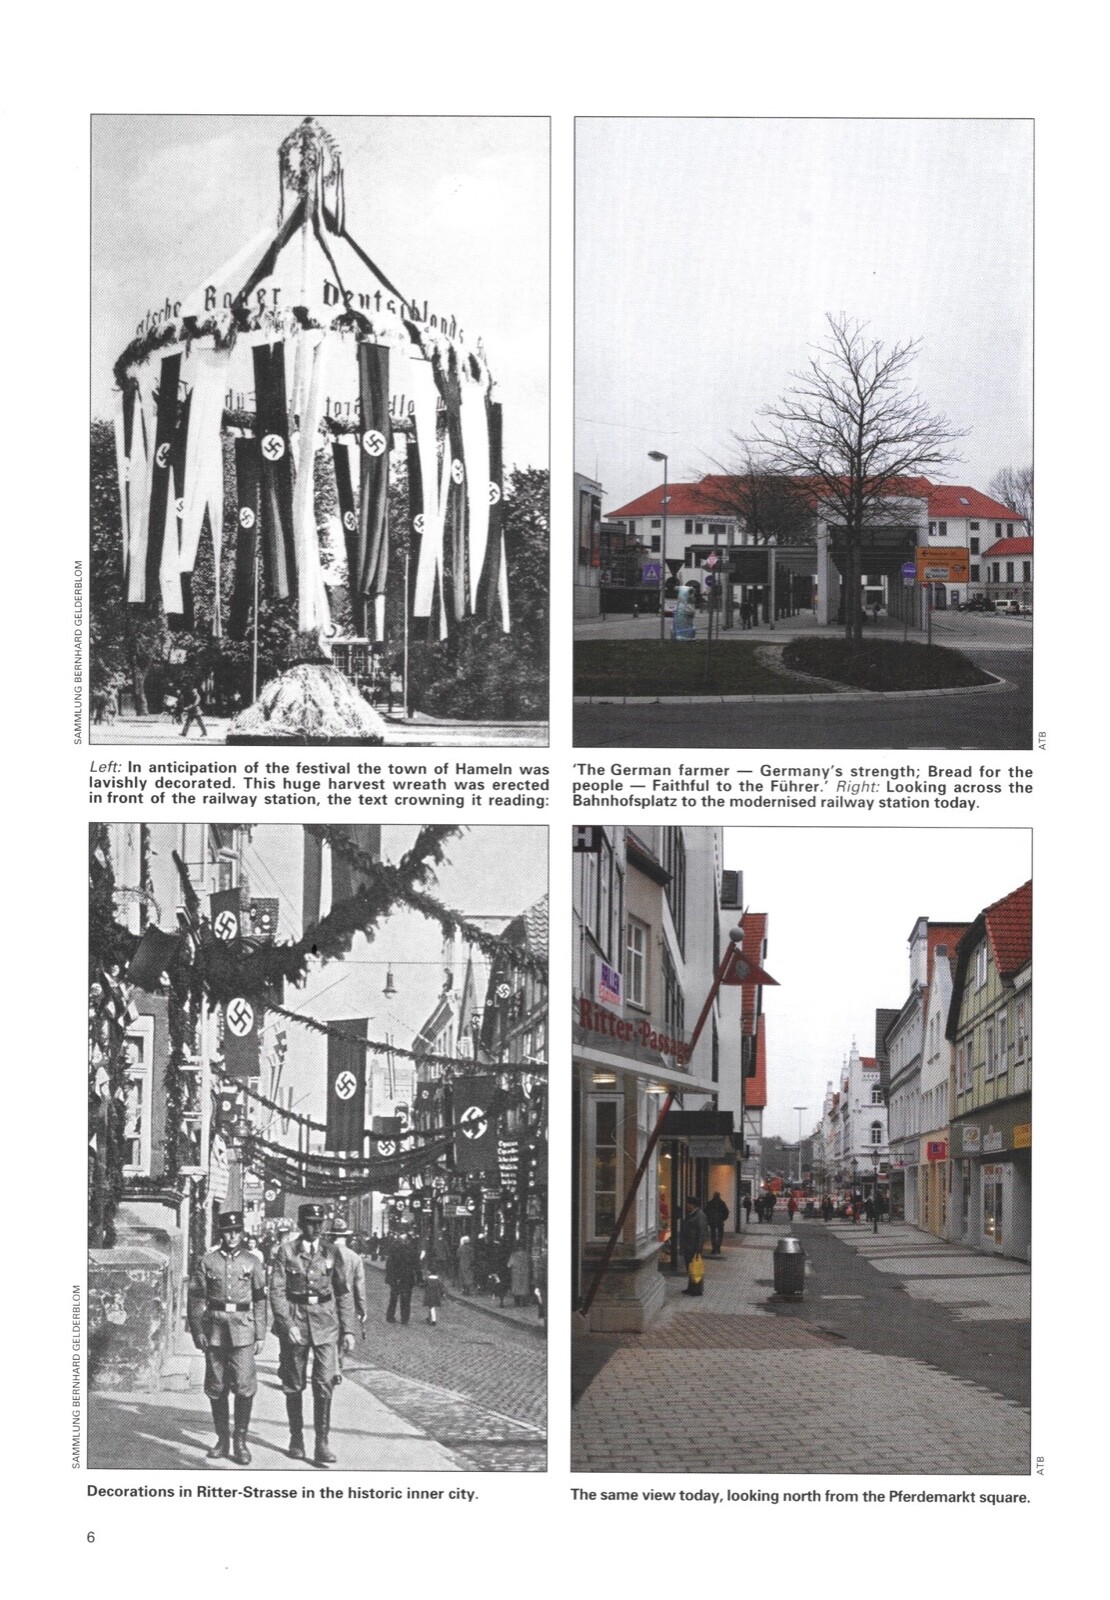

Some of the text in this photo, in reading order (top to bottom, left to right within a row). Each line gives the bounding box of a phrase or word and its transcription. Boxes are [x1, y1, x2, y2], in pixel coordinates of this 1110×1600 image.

[73, 560, 83, 745] SAMMLUNG BERNHARD GELDERBLOM
[1038, 731, 1047, 751] ATB
[89, 761, 550, 777] Left: In anticipation of the festival the town of Hameln was
[610, 763, 672, 781] German
[678, 763, 730, 777] farmer
[850, 765, 920, 781] strength;
[928, 765, 972, 778] Bread
[979, 765, 1001, 778] for
[1007, 765, 1034, 778] the
[88, 777, 550, 793] lavishly decorated. This huge harvest wreath was erected
[572, 782, 625, 796] people
[650, 779, 712, 792] Faithful
[716, 780, 732, 792] to
[738, 779, 764, 793] the
[836, 780, 880, 796] Right:
[886, 778, 947, 796] Looking
[953, 783, 1002, 794] across
[1008, 781, 1033, 794] the
[89, 791, 549, 809] in front of the railway station, the text crowning it reading:
[572, 794, 980, 812] Bahnhofsplatz to the modernised railway station today.
[71, 1285, 81, 1469] SAMMLUNG BERNHARD GELDERBLOM
[1036, 1456, 1045, 1476] ATB
[87, 1484, 479, 1503] Decorations in Ritter-Strasse in the historic inner city.
[570, 1488, 1031, 1506] The same view today, looking north from the Pferdemarkt square.
[86, 1531, 95, 1543] 6
